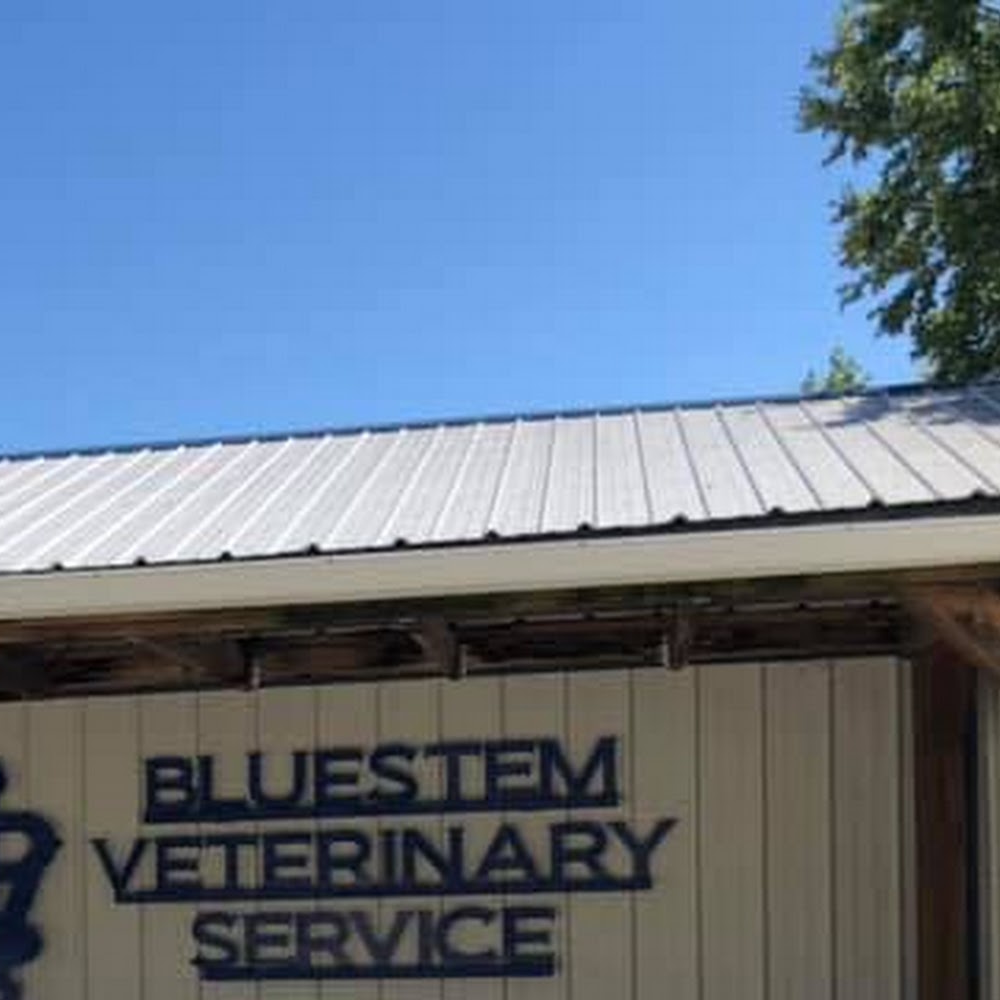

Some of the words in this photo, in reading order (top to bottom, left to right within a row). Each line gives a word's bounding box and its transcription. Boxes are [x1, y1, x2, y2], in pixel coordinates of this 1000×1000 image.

[144, 736, 620, 815] BLUESTEM
[91, 817, 678, 897] VETERINARY
[191, 906, 559, 970] SERVICE
